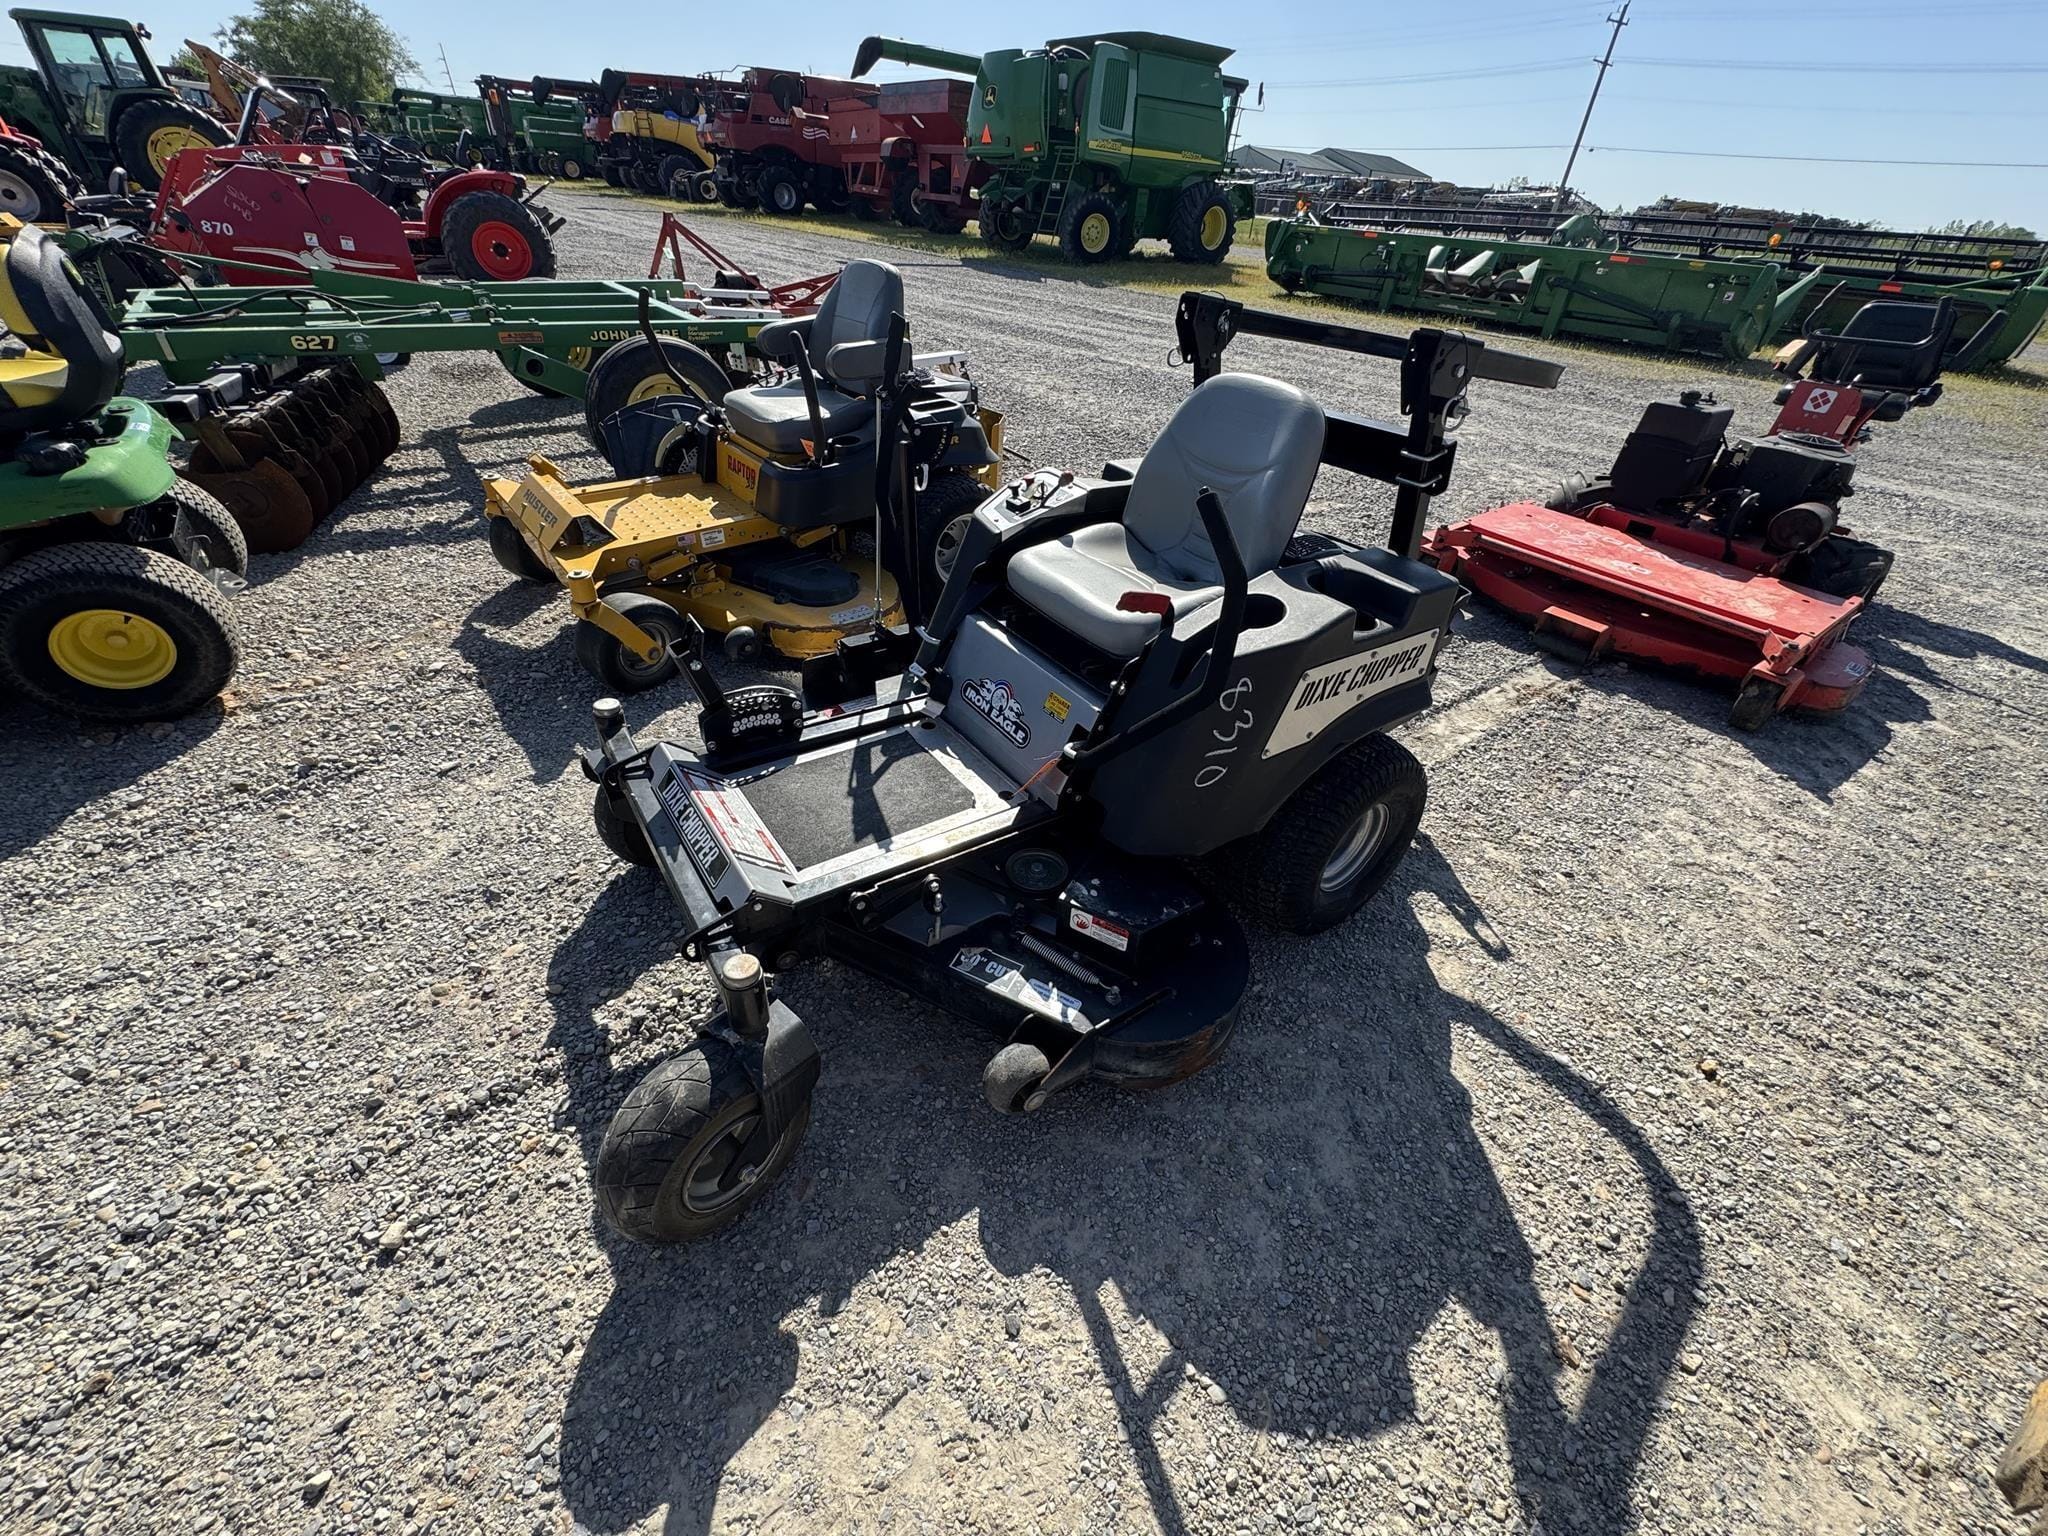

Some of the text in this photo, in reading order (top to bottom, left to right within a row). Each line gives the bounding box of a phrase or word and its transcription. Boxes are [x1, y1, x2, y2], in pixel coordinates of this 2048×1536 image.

[769, 116, 791, 126] CASE
[200, 219, 234, 236] 870
[290, 335, 335, 350] 627
[590, 330, 630, 341] JOHN
[727, 454, 756, 482] RAPTOR
[523, 488, 558, 528] HUSTLER
[1294, 643, 1428, 712] DIXIE CHOPPER
[964, 686, 1026, 743] IRON EAGLE
[1194, 677, 1253, 788] 8310
[662, 780, 689, 818] DIXIE
[679, 806, 720, 869] CHOPPER
